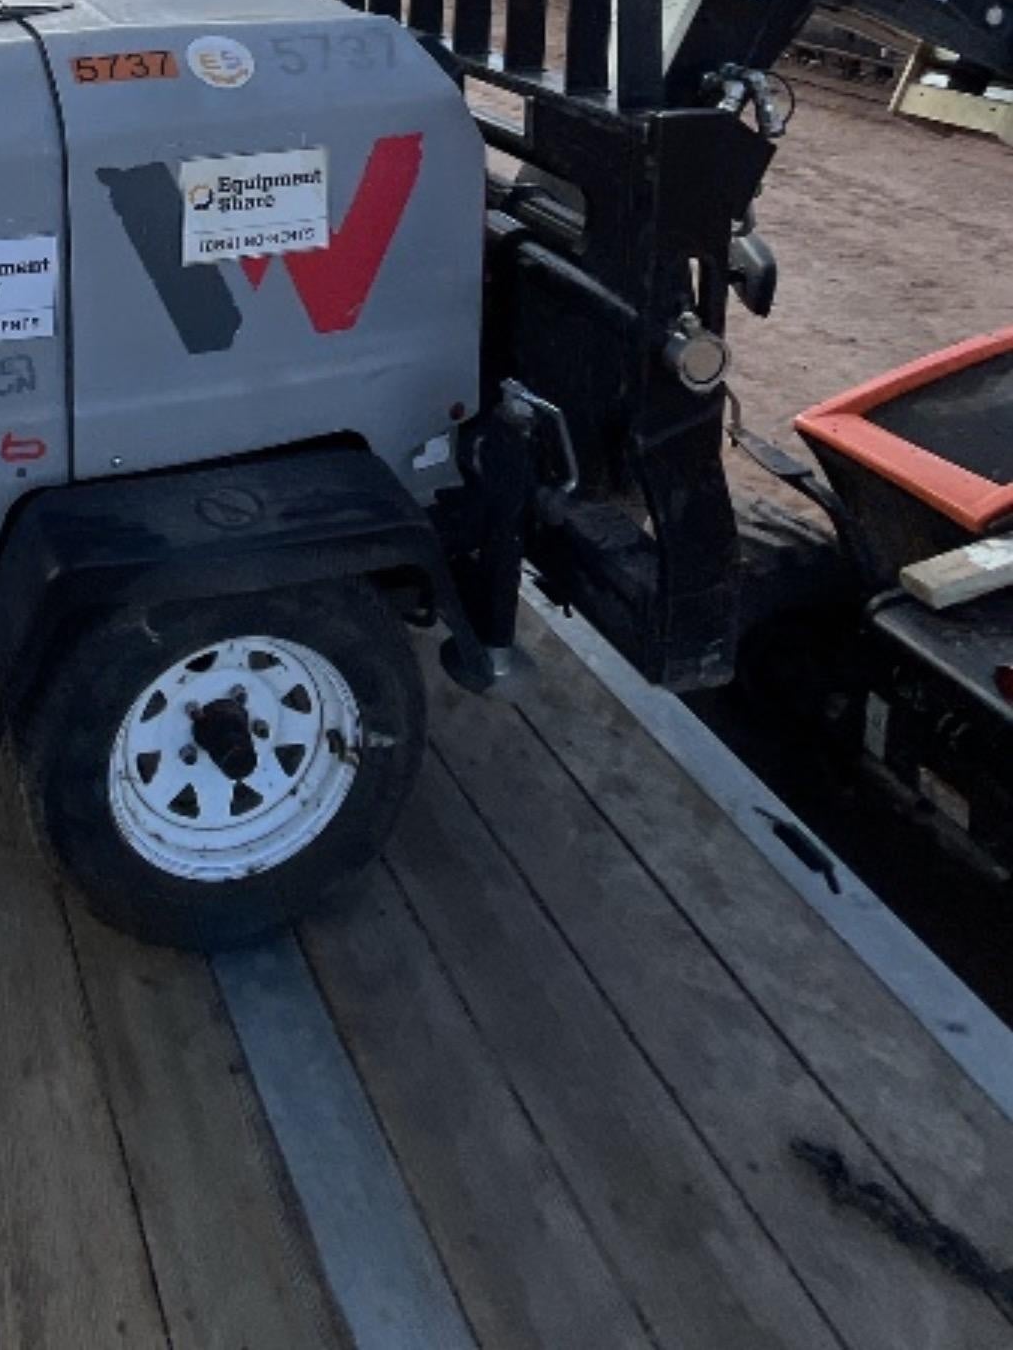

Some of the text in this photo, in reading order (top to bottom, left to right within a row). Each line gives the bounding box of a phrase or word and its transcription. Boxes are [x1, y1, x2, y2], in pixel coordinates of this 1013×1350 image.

[75, 52, 168, 82] 5737
[198, 50, 244, 70] ES
[217, 168, 322, 196] Equipment
[217, 194, 276, 213] Share
